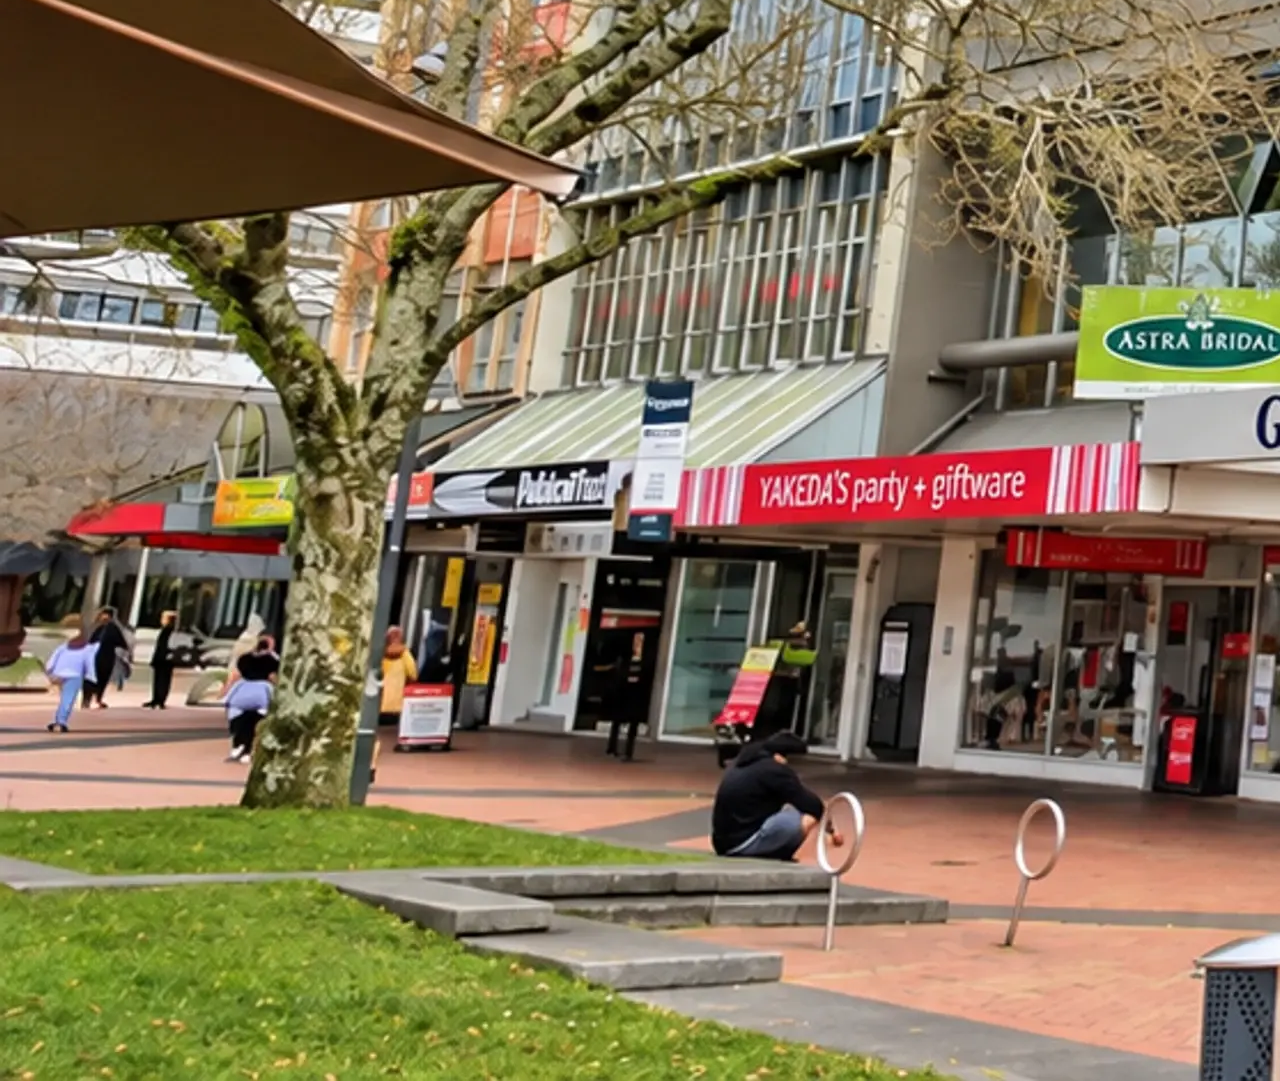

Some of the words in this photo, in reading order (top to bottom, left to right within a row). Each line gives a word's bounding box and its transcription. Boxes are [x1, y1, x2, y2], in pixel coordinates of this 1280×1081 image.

[1118, 331, 1190, 350] ASTRA
[1201, 333, 1278, 352] BRIDAL
[760, 470, 851, 508] YAKEDA'S
[852, 470, 909, 512] party
[931, 463, 1026, 510] giftware
